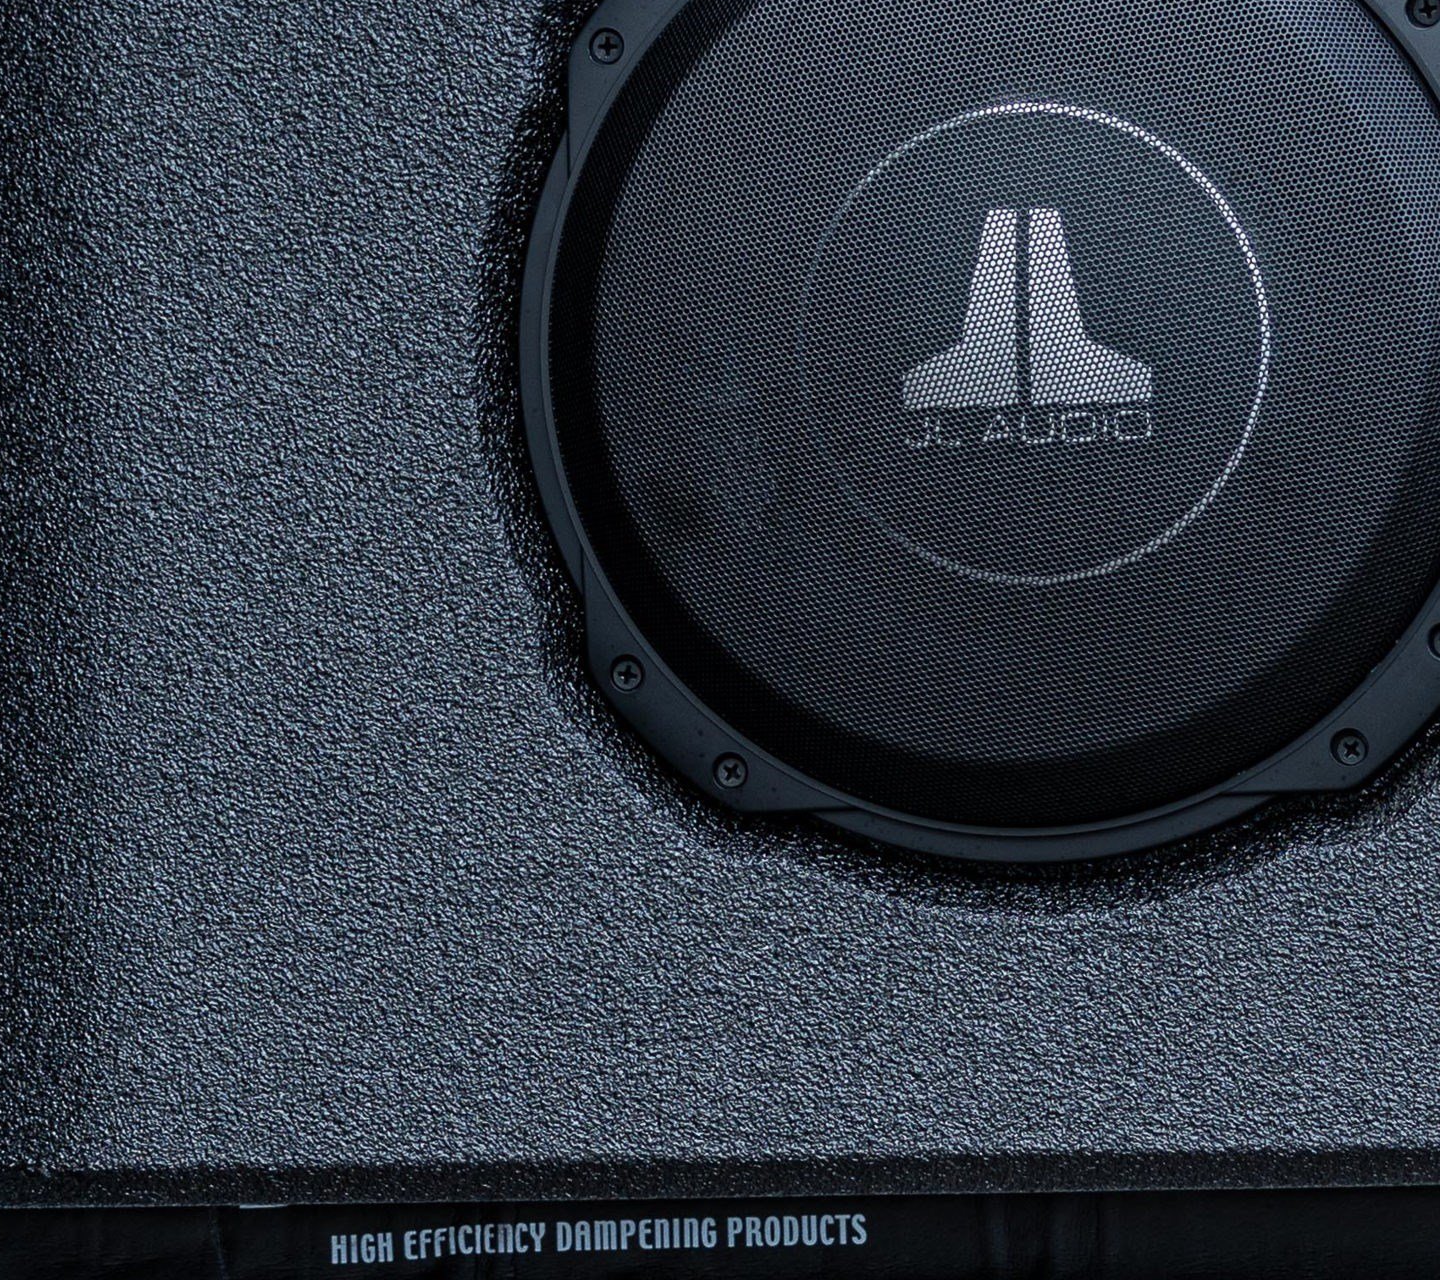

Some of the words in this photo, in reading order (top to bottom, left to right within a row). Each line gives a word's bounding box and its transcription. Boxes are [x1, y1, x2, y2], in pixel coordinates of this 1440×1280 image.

[981, 410, 1153, 444] AUDIO
[330, 1231, 394, 1265] HIGH
[402, 1222, 547, 1261] EFFICIENCY
[555, 1217, 718, 1253] DAMPENING
[726, 1213, 868, 1248] PRODUCTS
